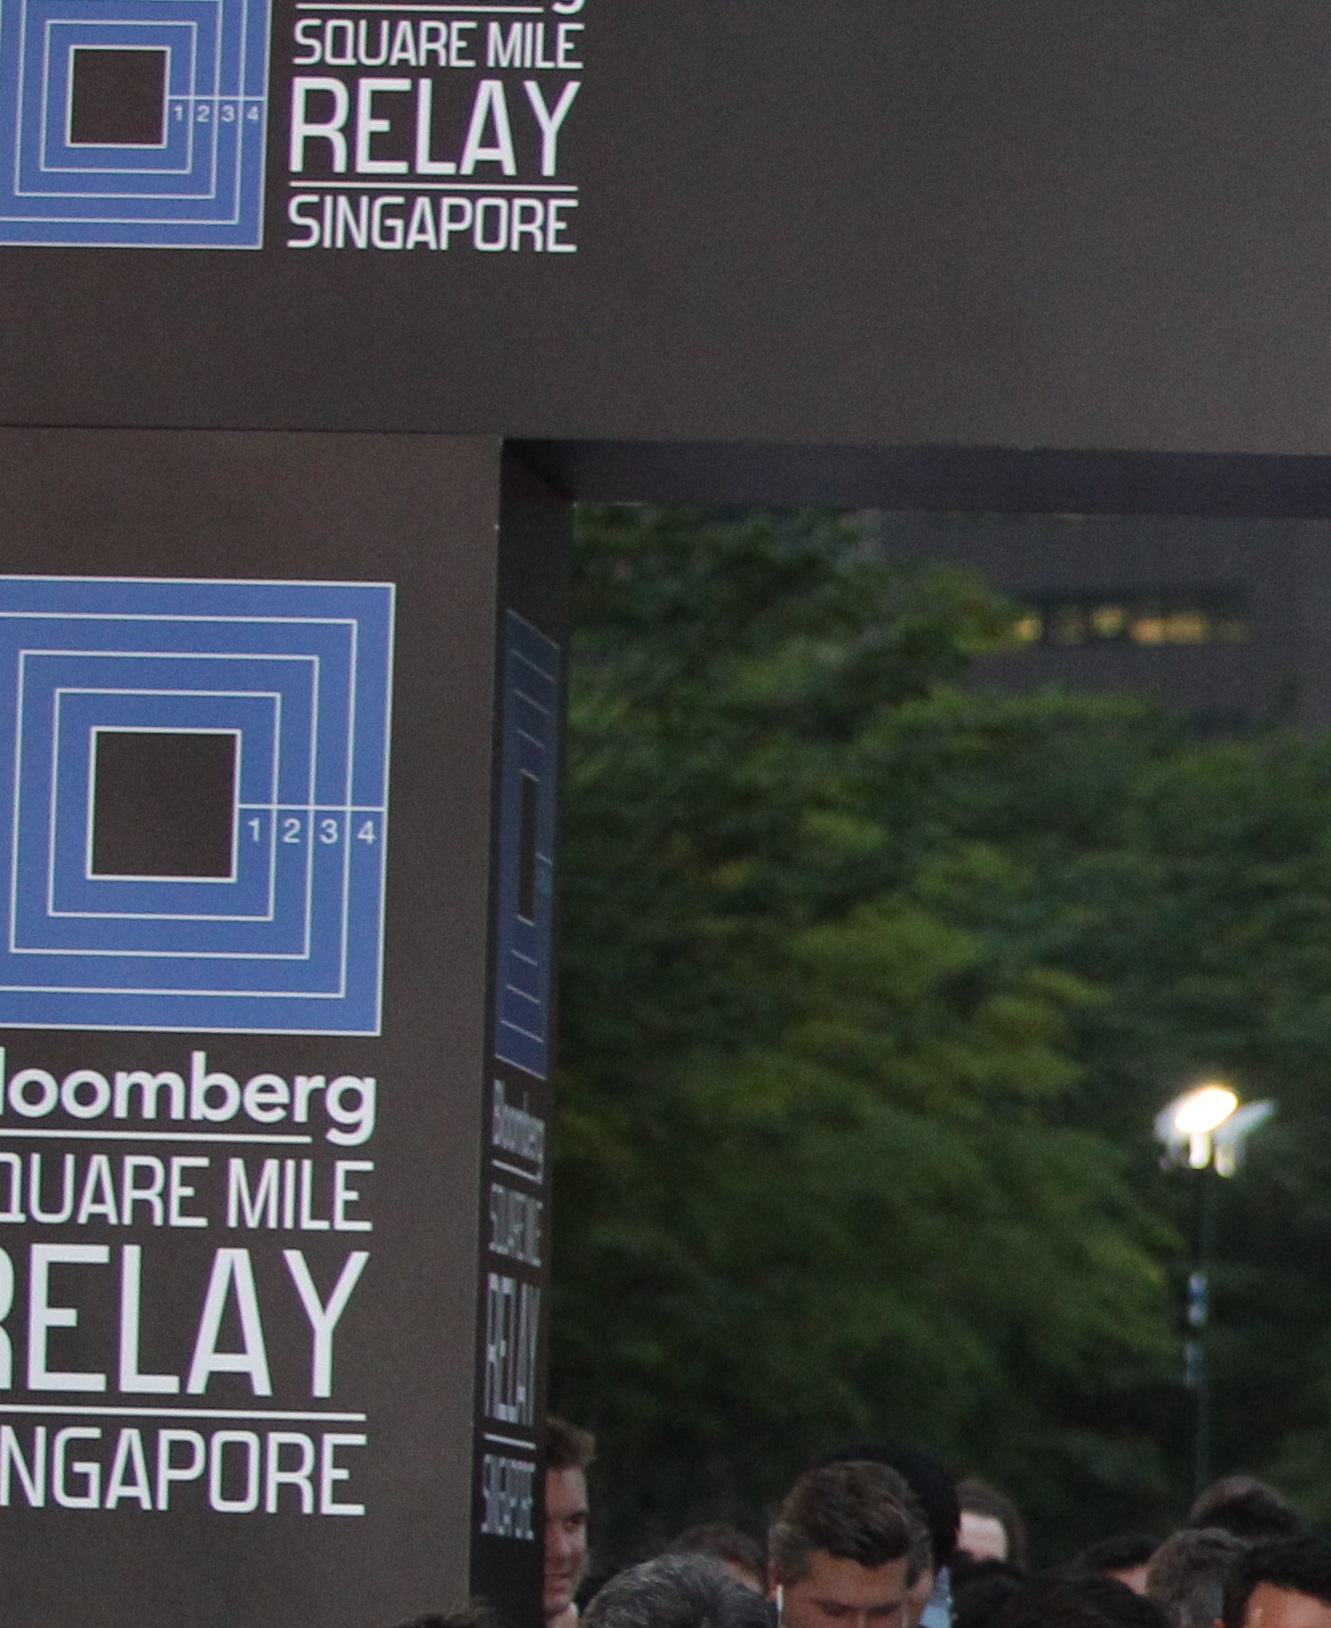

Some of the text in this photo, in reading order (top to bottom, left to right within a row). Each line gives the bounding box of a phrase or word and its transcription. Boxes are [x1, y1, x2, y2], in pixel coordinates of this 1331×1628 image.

[293, 19, 585, 70] SQUARE MILE
[173, 106, 260, 123] 1 2 3 4
[288, 76, 582, 178] RELAY
[286, 195, 579, 254] SINGAPORE
[248, 819, 375, 845] 1 2 3 4
[0, 1051, 377, 1146] oomberg
[0, 1153, 375, 1232] QUARE MILE
[0, 1242, 371, 1399] ELAY
[0, 1424, 367, 1517] NGAPORE
